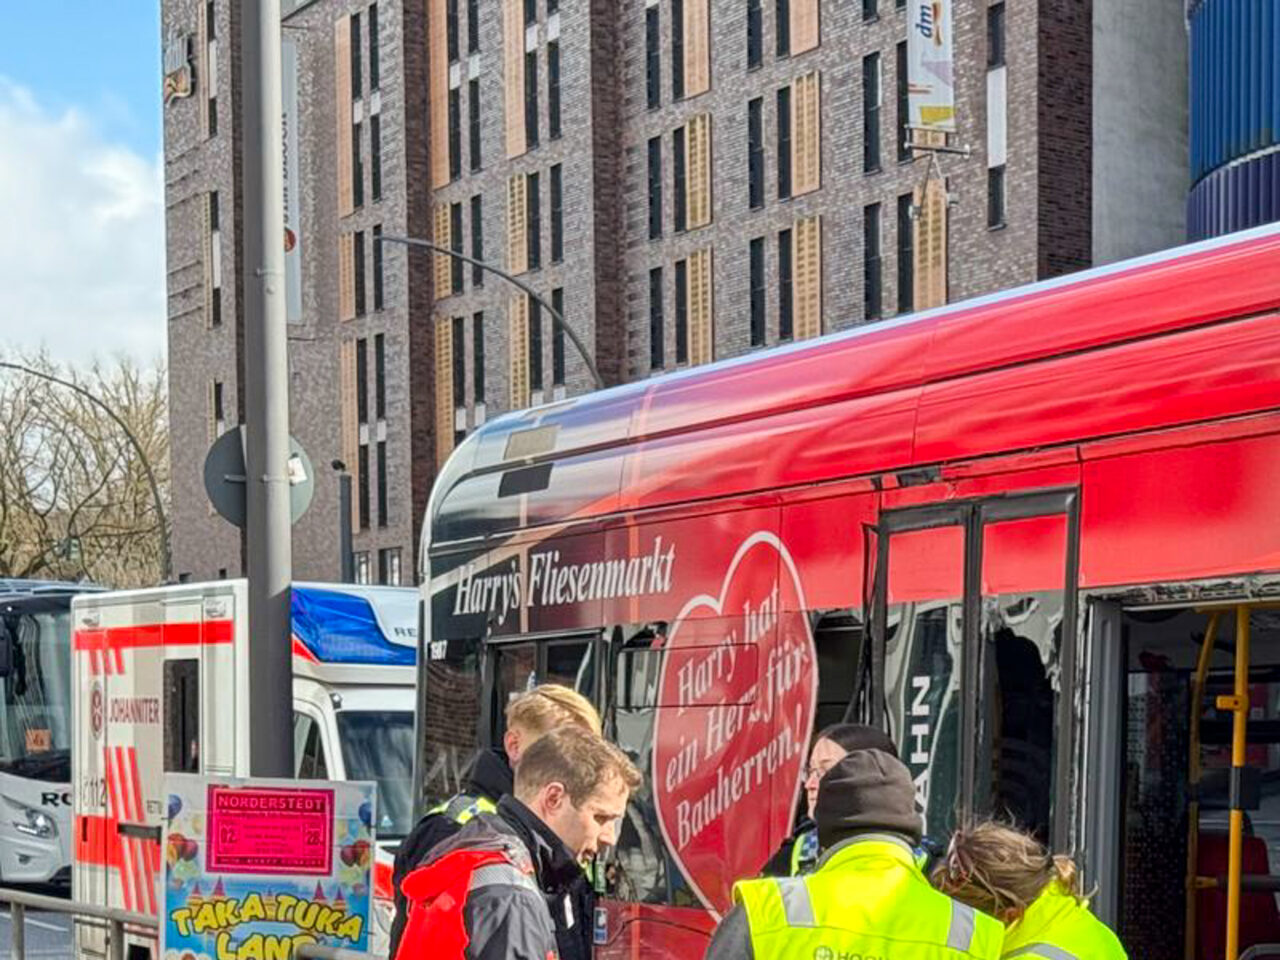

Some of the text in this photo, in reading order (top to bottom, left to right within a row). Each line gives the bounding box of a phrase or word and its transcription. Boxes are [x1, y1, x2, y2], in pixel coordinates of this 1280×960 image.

[915, 5, 932, 38] dm
[452, 536, 675, 625] Harry's Fliesenmarkt
[677, 579, 779, 715] Harry hat
[109, 697, 160, 724] JOHANNITER
[666, 641, 809, 792] ein Herz für
[218, 795, 323, 810] NORDERSTEDT
[675, 703, 801, 851] Bauherren!
[172, 892, 365, 943] TAKA TUKA
